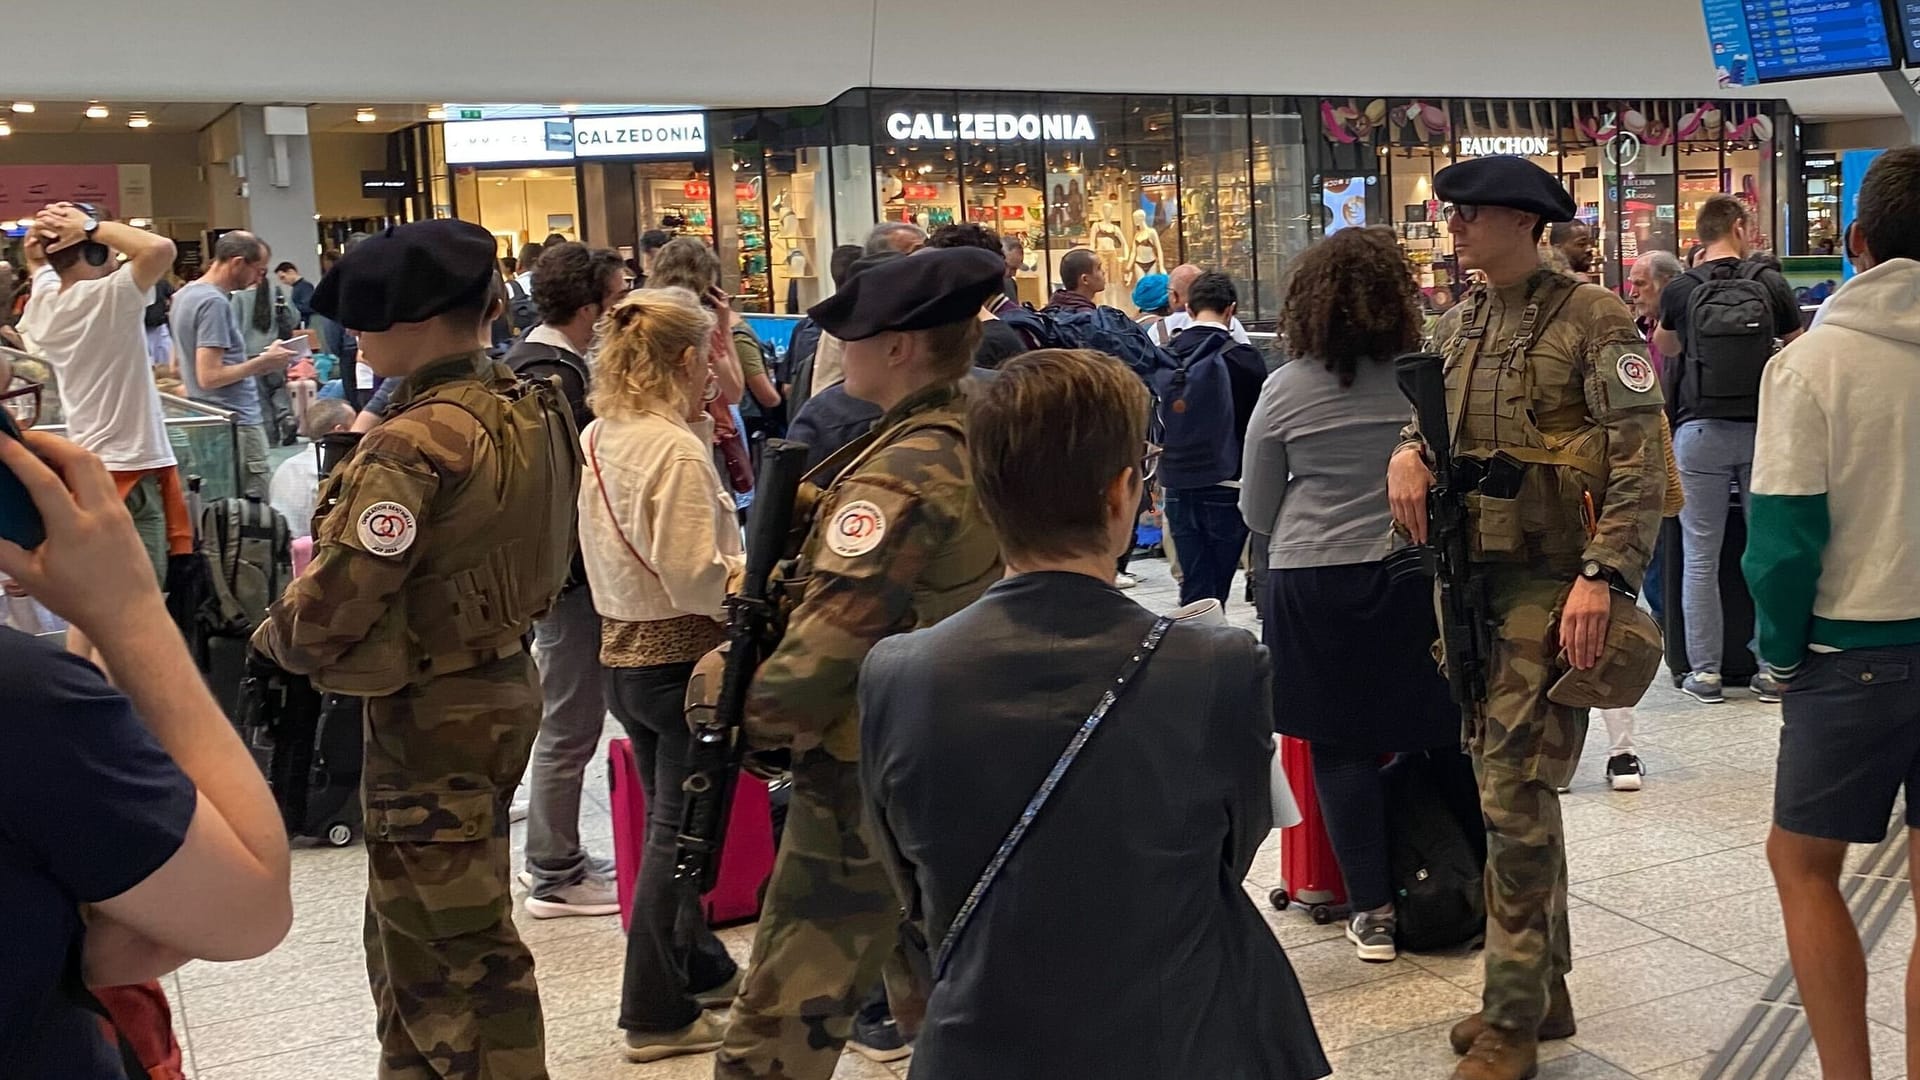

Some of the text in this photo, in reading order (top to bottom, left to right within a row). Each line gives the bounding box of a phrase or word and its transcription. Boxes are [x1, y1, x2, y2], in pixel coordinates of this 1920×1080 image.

[578, 126, 703, 146] CALZEDONIA
[886, 112, 1095, 140] CALZEDONIA
[1460, 136, 1549, 155] FAUCHON
